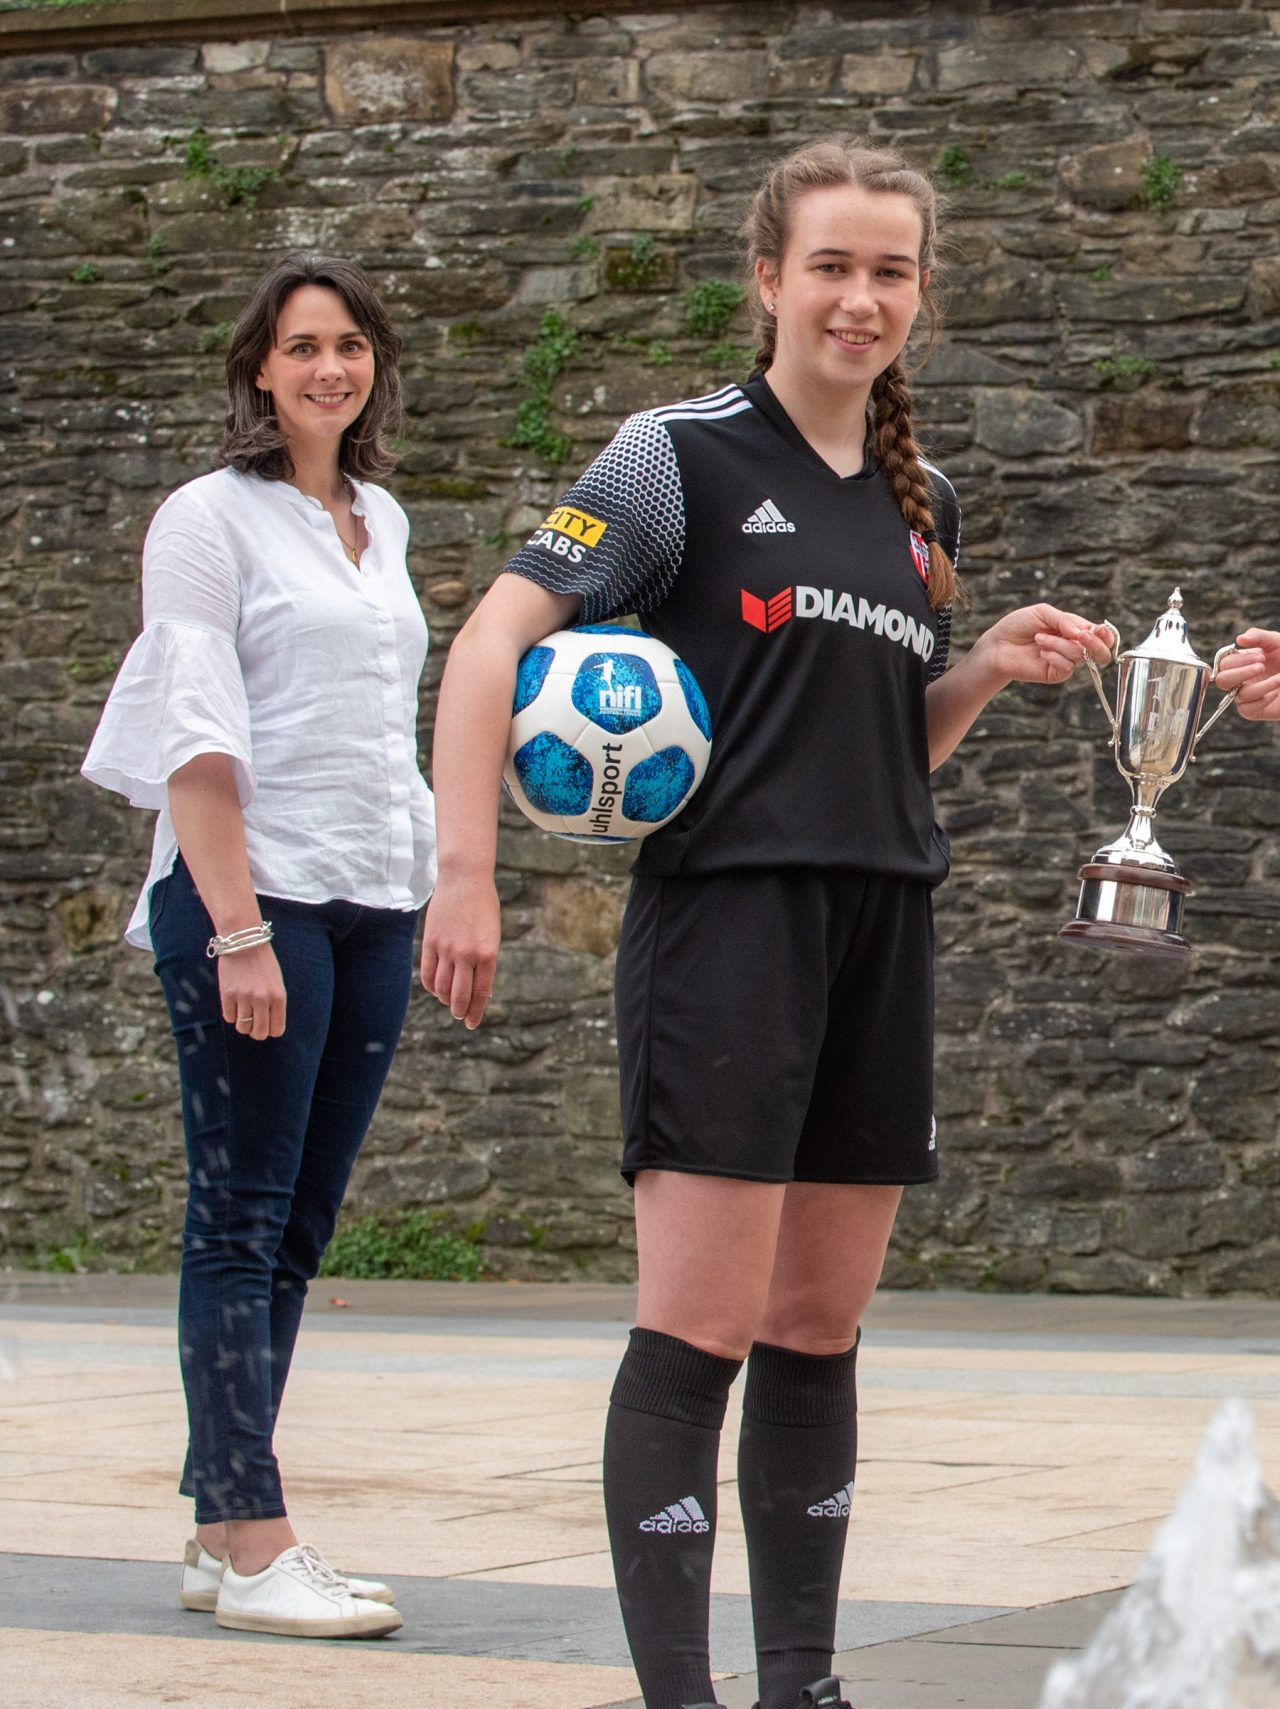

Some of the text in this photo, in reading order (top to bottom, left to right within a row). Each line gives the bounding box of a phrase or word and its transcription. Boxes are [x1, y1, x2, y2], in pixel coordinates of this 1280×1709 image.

[543, 510, 597, 537] CITY
[742, 521, 796, 533] adidas
[527, 530, 586, 563] CABS
[796, 585, 935, 663] DIAMOND
[599, 683, 642, 709] nifl
[589, 743, 623, 833] uhlsport
[639, 1519, 710, 1534] adidas
